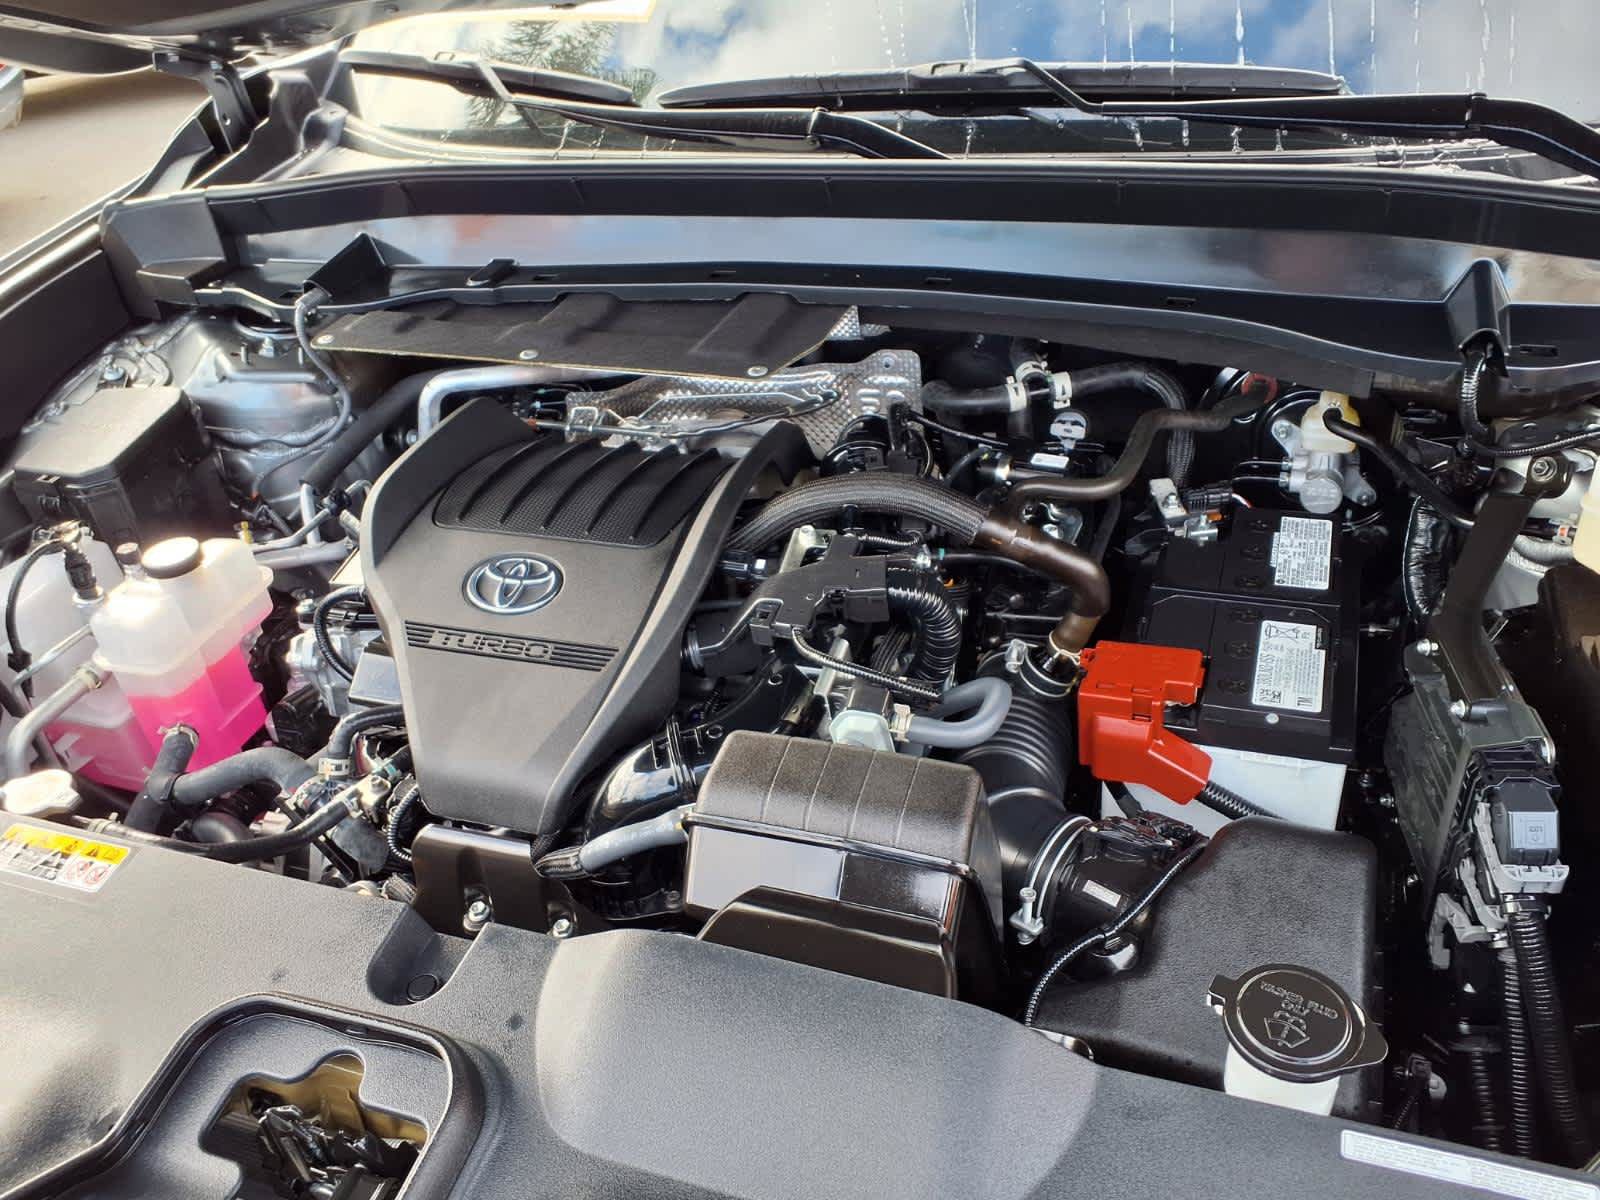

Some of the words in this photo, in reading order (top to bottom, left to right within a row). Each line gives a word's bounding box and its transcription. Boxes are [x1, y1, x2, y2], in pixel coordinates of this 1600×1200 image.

[429, 630, 552, 661] TURBO
[1260, 981, 1304, 1004] WASHER
[1307, 1000, 1338, 1019] FLUID
[1281, 1000, 1311, 1017] ONLY
